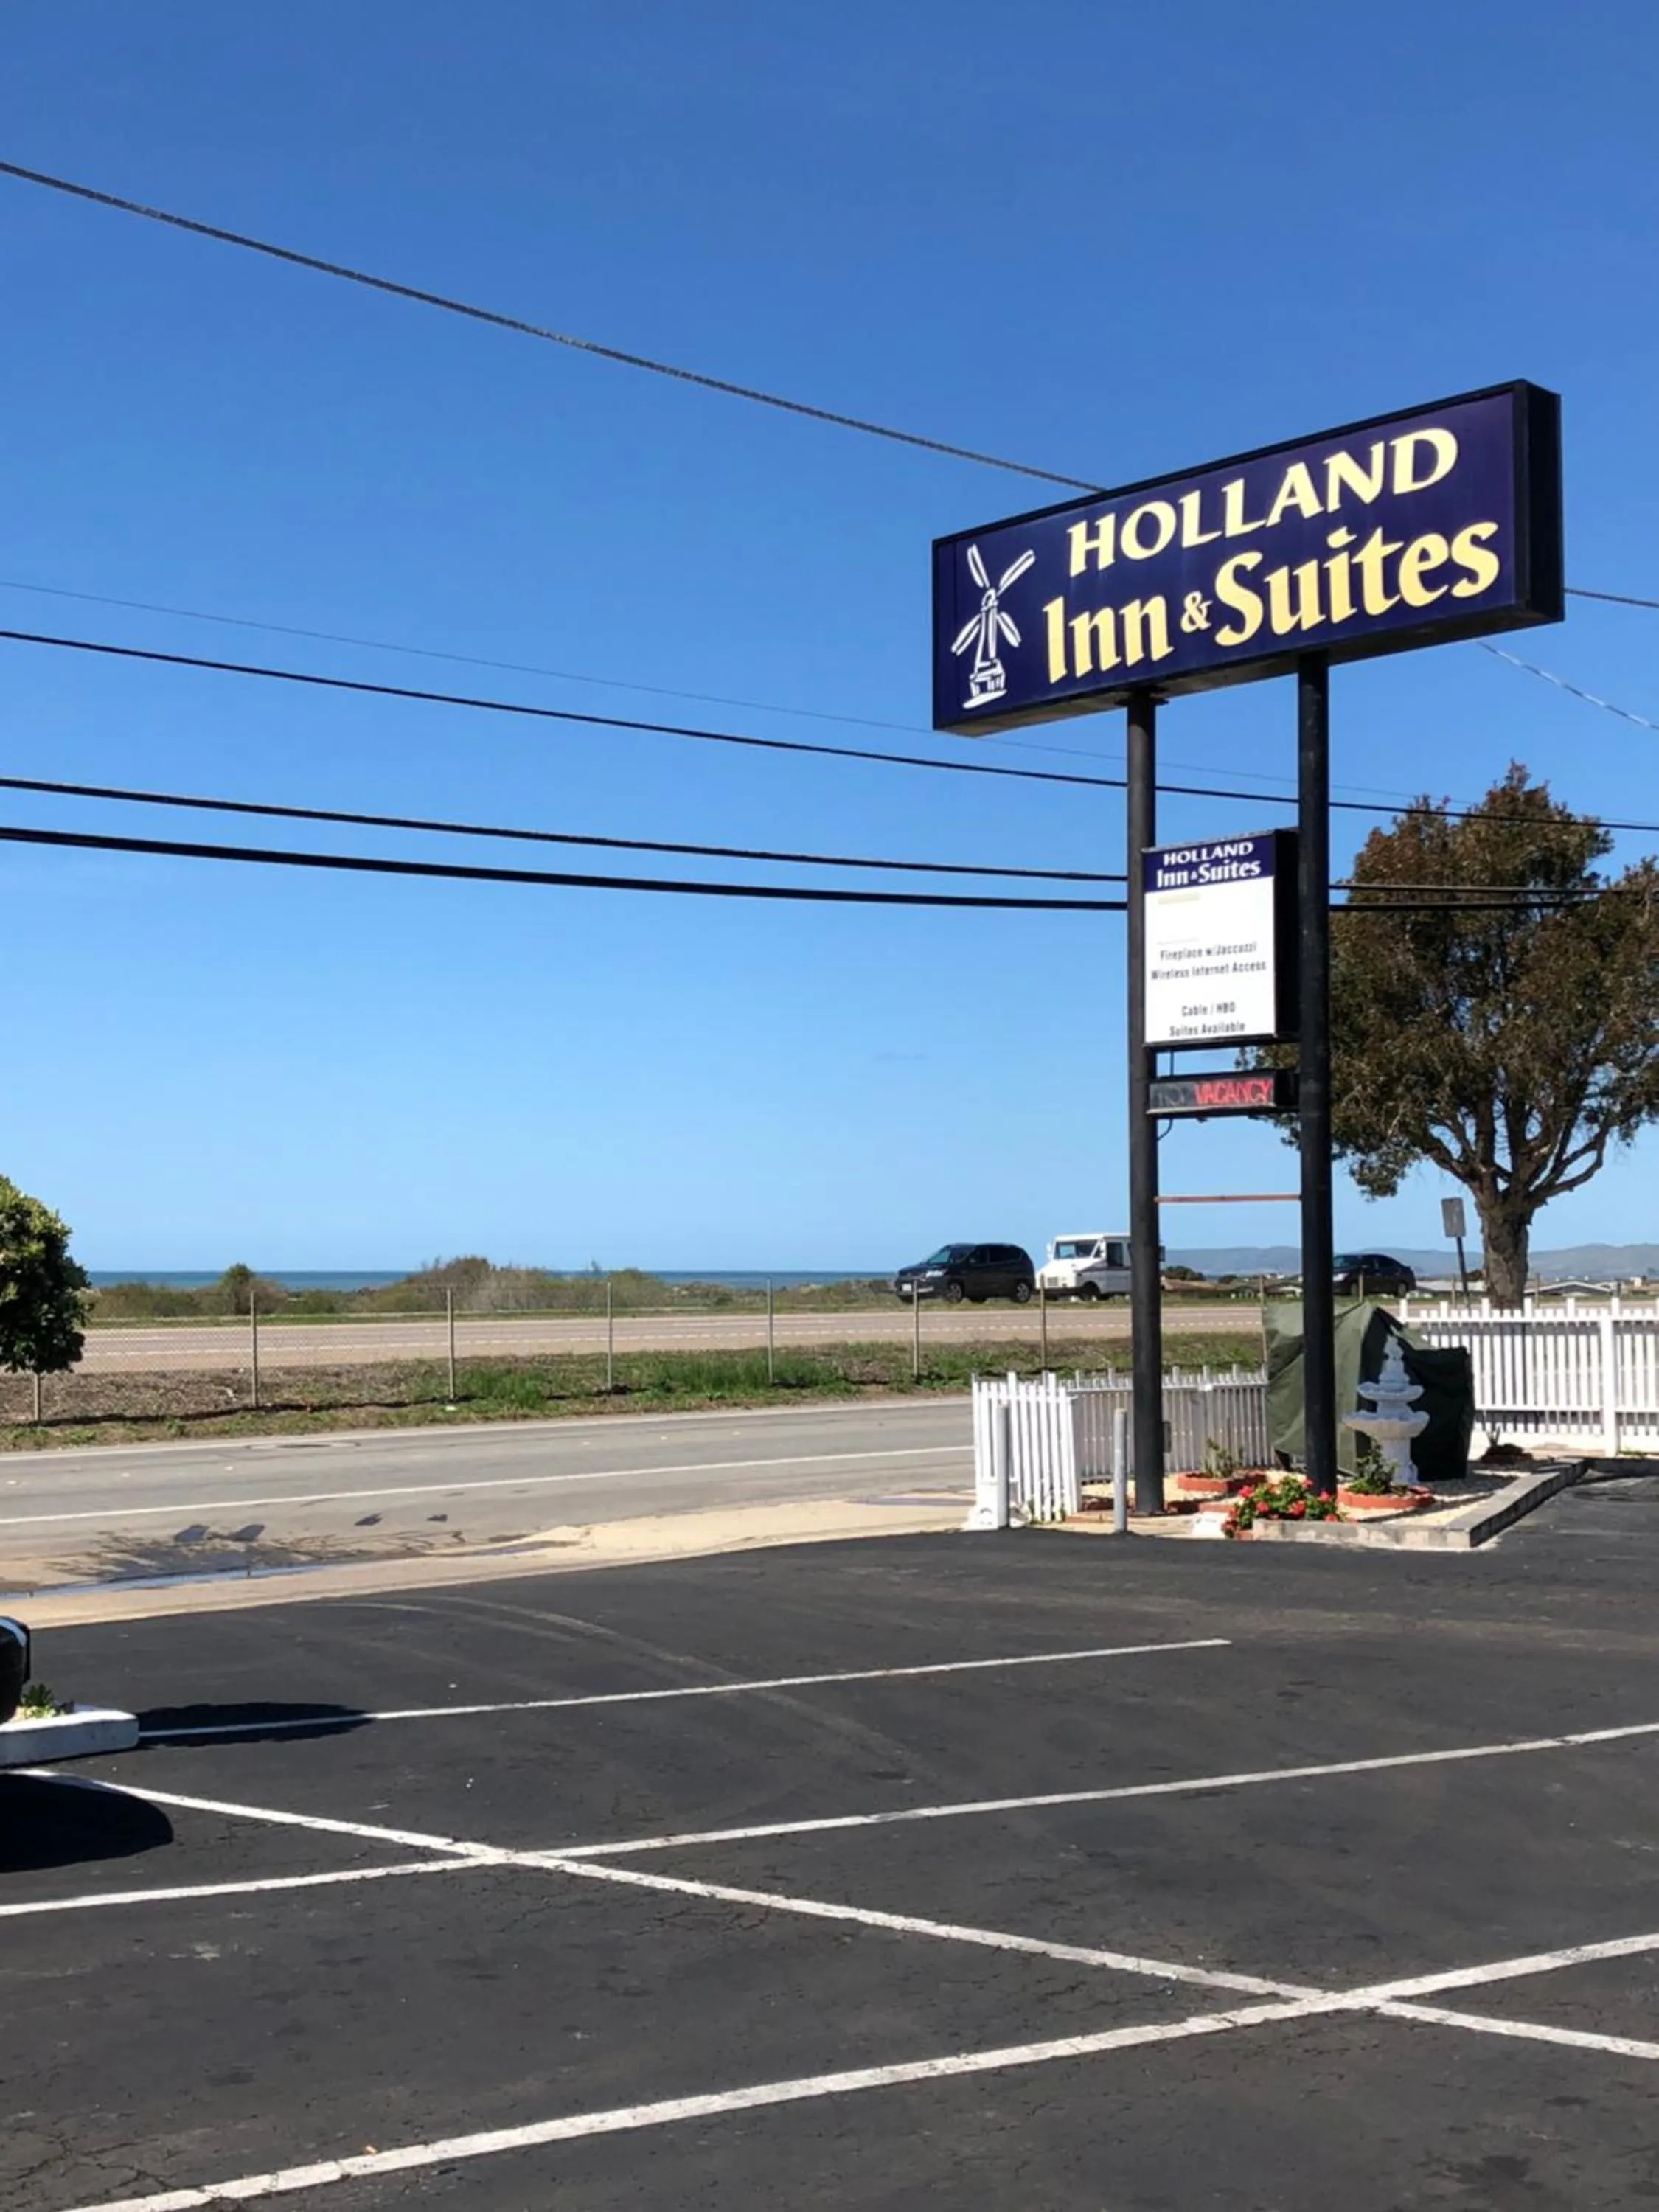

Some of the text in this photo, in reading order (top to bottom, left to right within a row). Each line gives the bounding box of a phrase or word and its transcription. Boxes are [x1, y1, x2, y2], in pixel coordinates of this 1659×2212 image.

[1068, 428, 1458, 577] HOLLAND
[1043, 521, 1500, 684] Inn & Suites
[1163, 841, 1253, 866] HOLLAND
[1157, 869, 1189, 888] Inn
[1198, 859, 1262, 883] Suites
[1160, 948, 1203, 961] Fireplace
[1151, 961, 1267, 980] Wireless Internet Access
[1181, 1004, 1208, 1017] Cable
[1216, 1001, 1236, 1013] HBO
[1169, 1021, 1245, 1037] Suites Available
[1196, 1079, 1273, 1107] VACANCY
